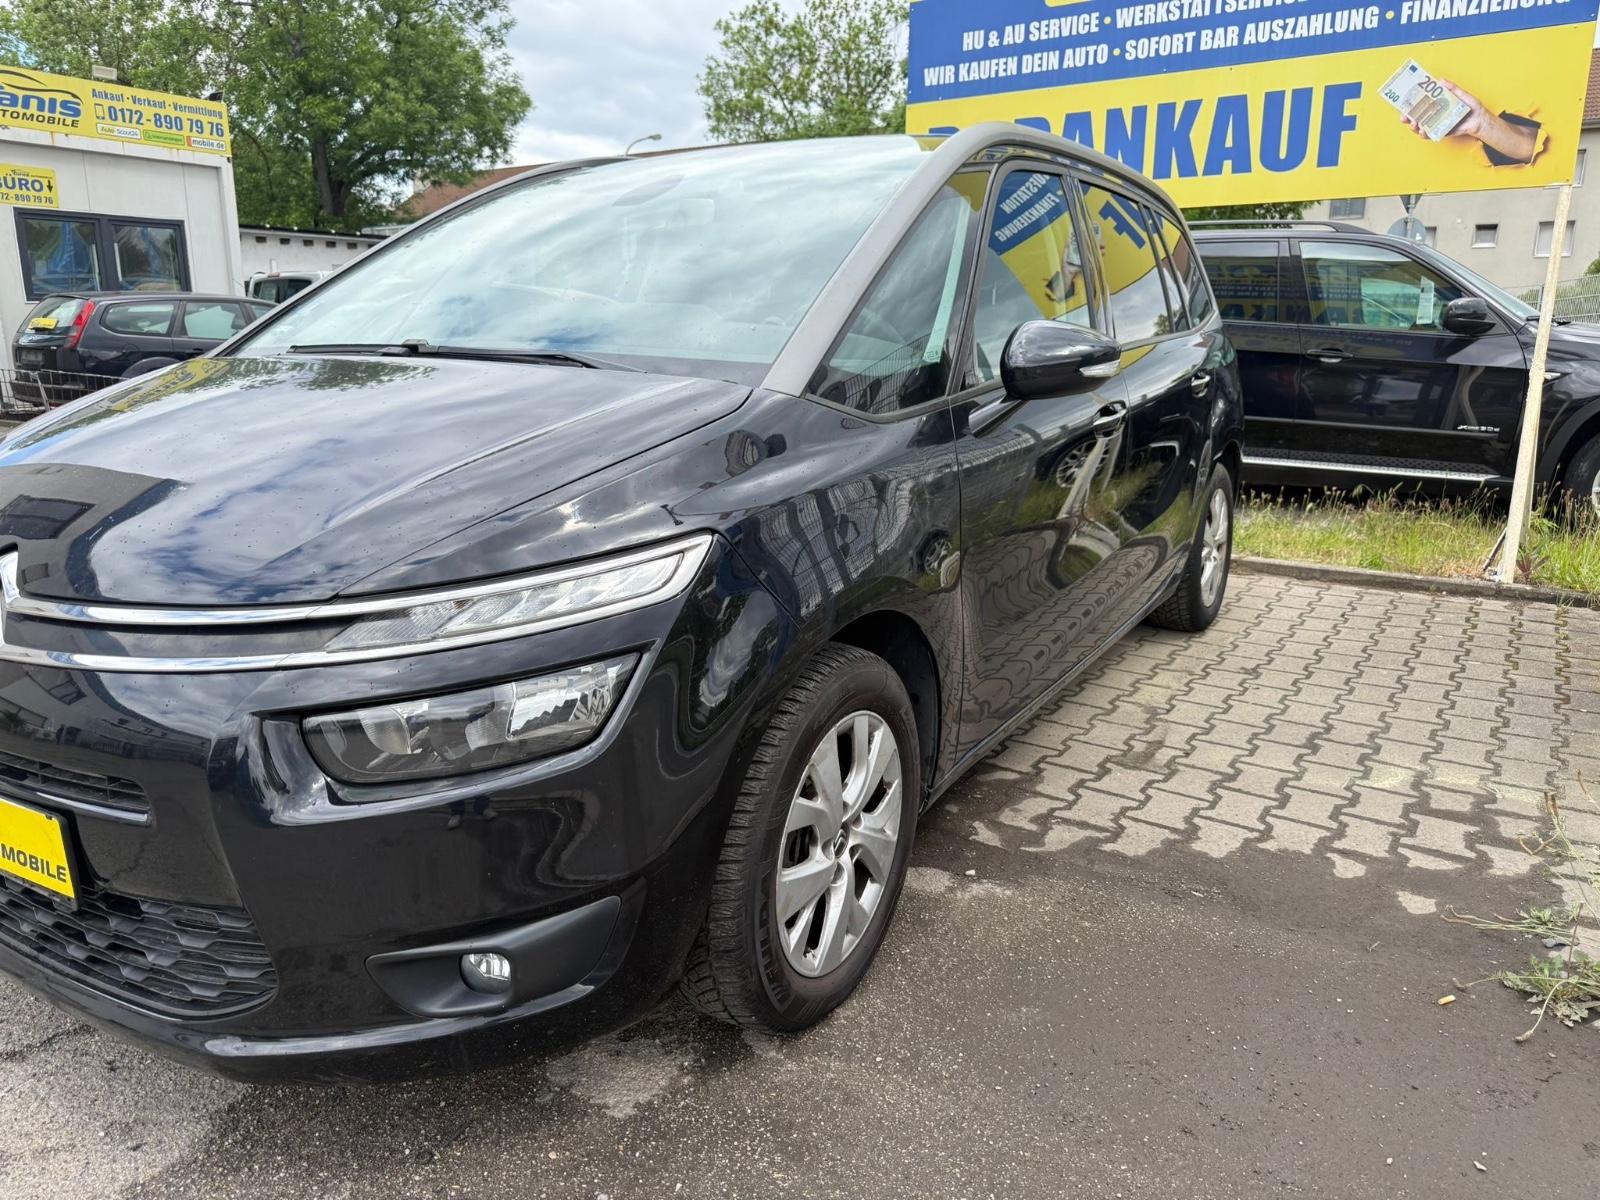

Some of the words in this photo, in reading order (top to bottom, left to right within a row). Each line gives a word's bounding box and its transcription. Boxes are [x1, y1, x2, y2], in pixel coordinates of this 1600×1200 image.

[962, 30, 985, 51] HU
[987, 31, 1000, 47] &
[1003, 23, 1026, 45] AU
[1029, 12, 1100, 42] SERVICE
[1116, 0, 1311, 29] WERKSTATTSE
[924, 65, 955, 87] WIR
[958, 56, 1018, 82] KAUFEN
[1021, 50, 1060, 74] DEIN
[1063, 43, 1109, 69] AUTO
[1125, 31, 1197, 61] SOFORT
[1199, 25, 1240, 51] BAR
[1243, 5, 1380, 45] AUSZAHLUNG
[1400, 0, 1570, 25] FINANZIE
[0, 85, 82, 118] anis
[1384, 88, 1400, 103] 200
[1417, 75, 1444, 99] 200
[92, 88, 124, 102] Ankauf
[131, 95, 166, 110] Verkauf
[172, 101, 223, 119] Vermittlung
[187, 117, 204, 135] 79
[207, 121, 224, 138] 76
[928, 81, 1363, 181] NKAUF
[192, 139, 225, 150] mobile.de
[0, 843, 67, 883] MOBILE
